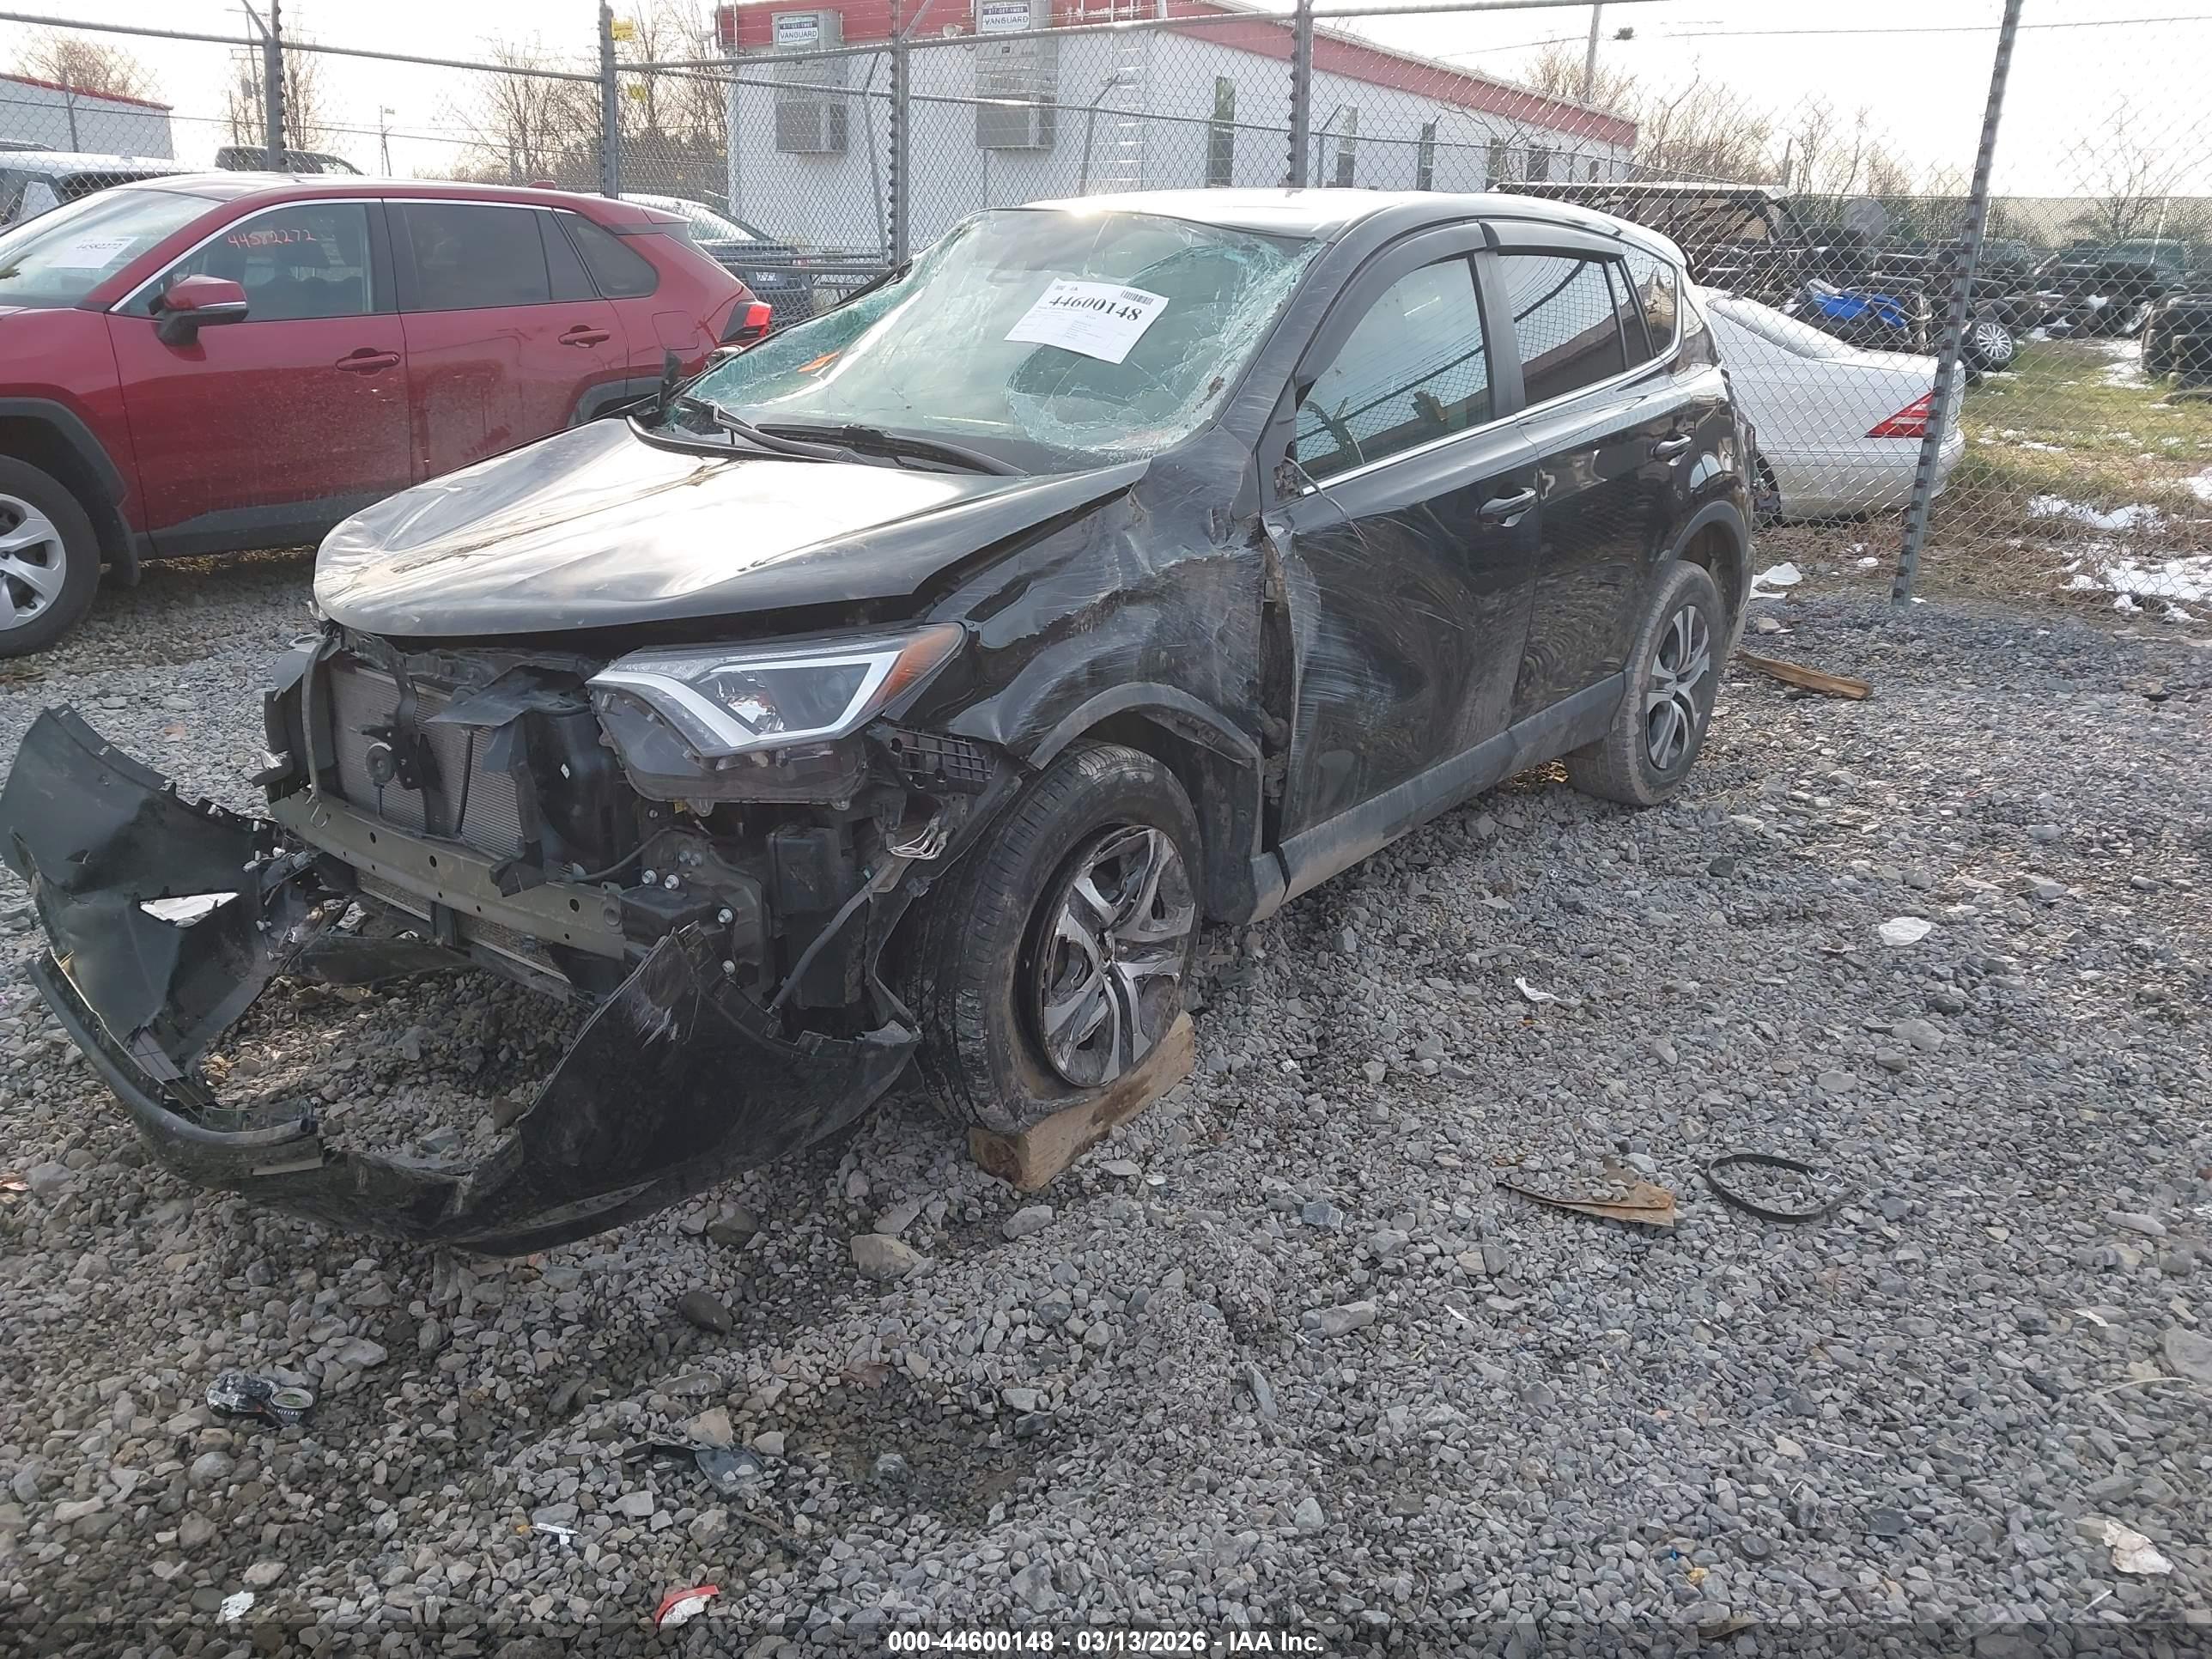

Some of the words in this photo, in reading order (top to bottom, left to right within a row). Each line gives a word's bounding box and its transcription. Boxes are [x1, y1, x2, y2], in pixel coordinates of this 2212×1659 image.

[984, 15, 1029, 26] VANGUARD
[780, 30, 817, 40] VANGUARD
[1048, 295, 1143, 322] 44600148
